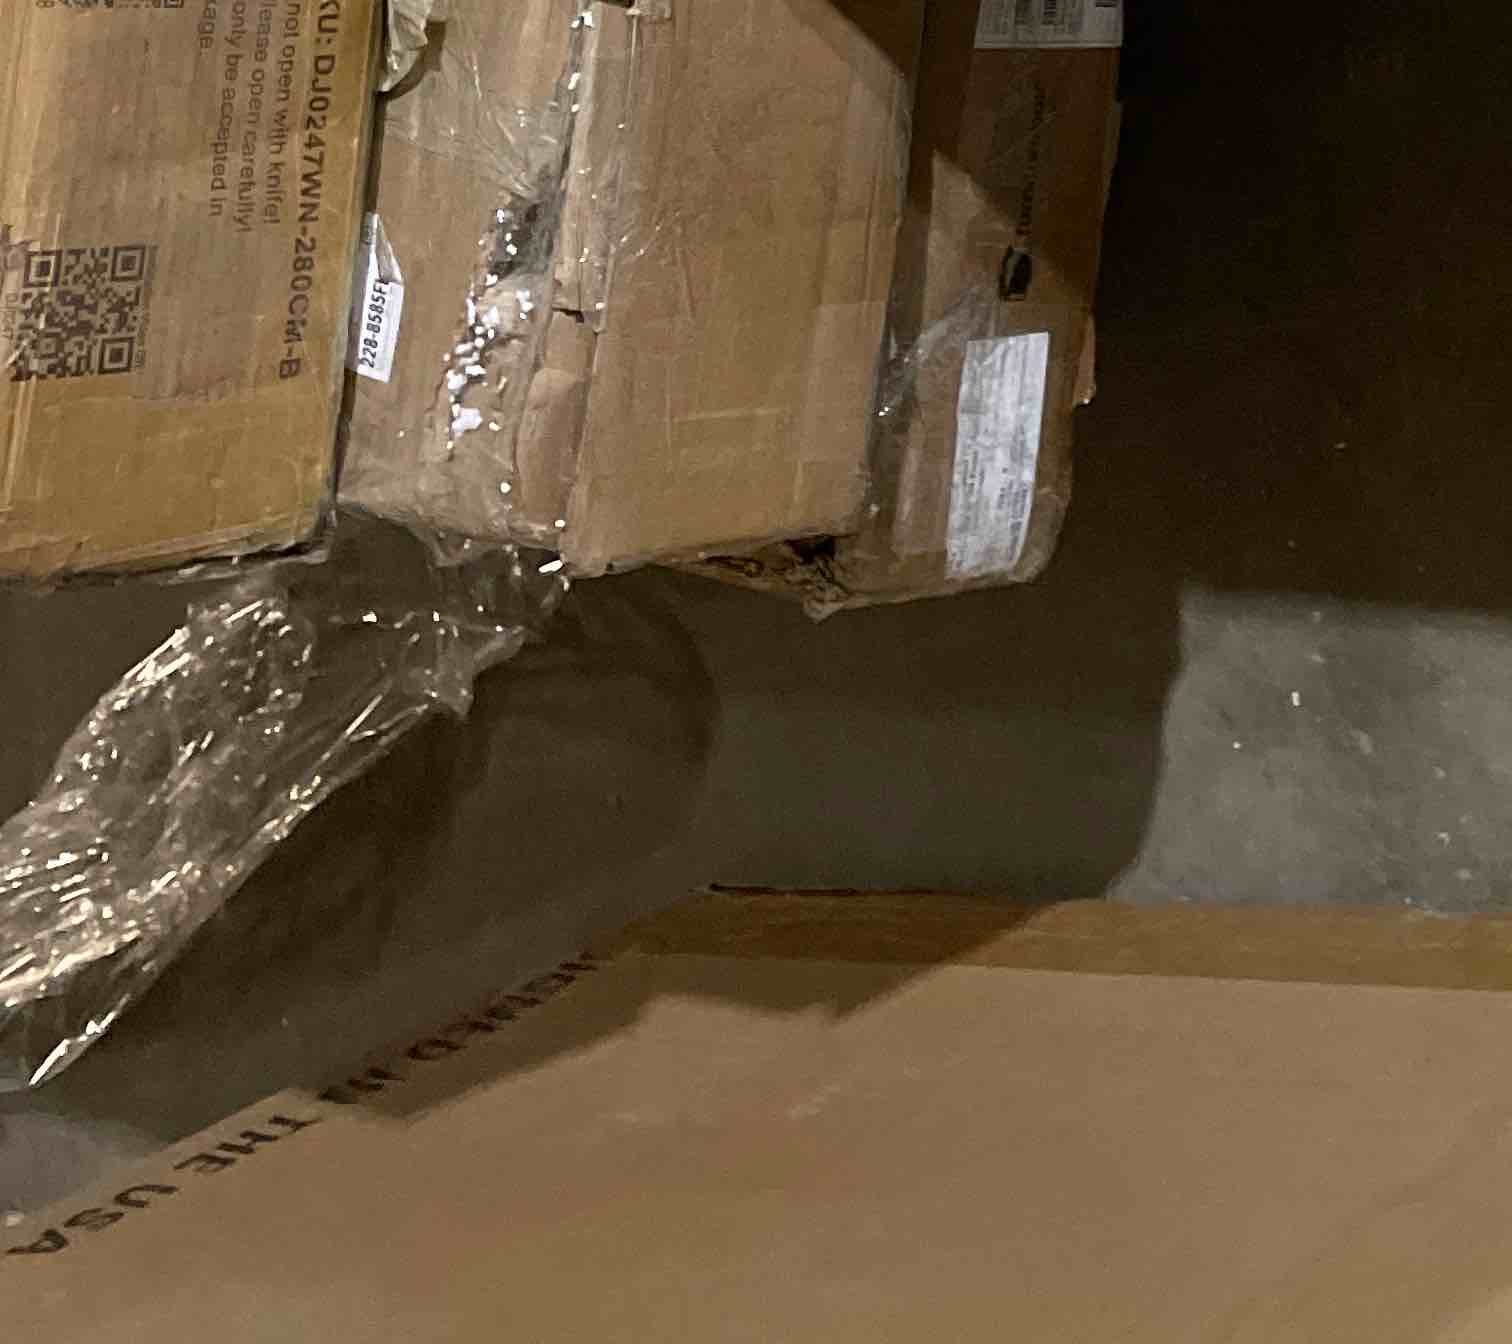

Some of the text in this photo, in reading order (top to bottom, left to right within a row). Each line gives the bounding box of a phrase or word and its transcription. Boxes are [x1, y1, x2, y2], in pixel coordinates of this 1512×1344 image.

[225, 0, 250, 48] only
[282, 2, 303, 39] not
[224, 53, 244, 82] be
[273, 44, 296, 103] open
[245, 66, 267, 125] open
[209, 86, 241, 191] accepted
[269, 107, 291, 155] with
[208, 196, 228, 217] in
[173, 1114, 329, 1174] THE
[2, 1182, 179, 1257] USA
